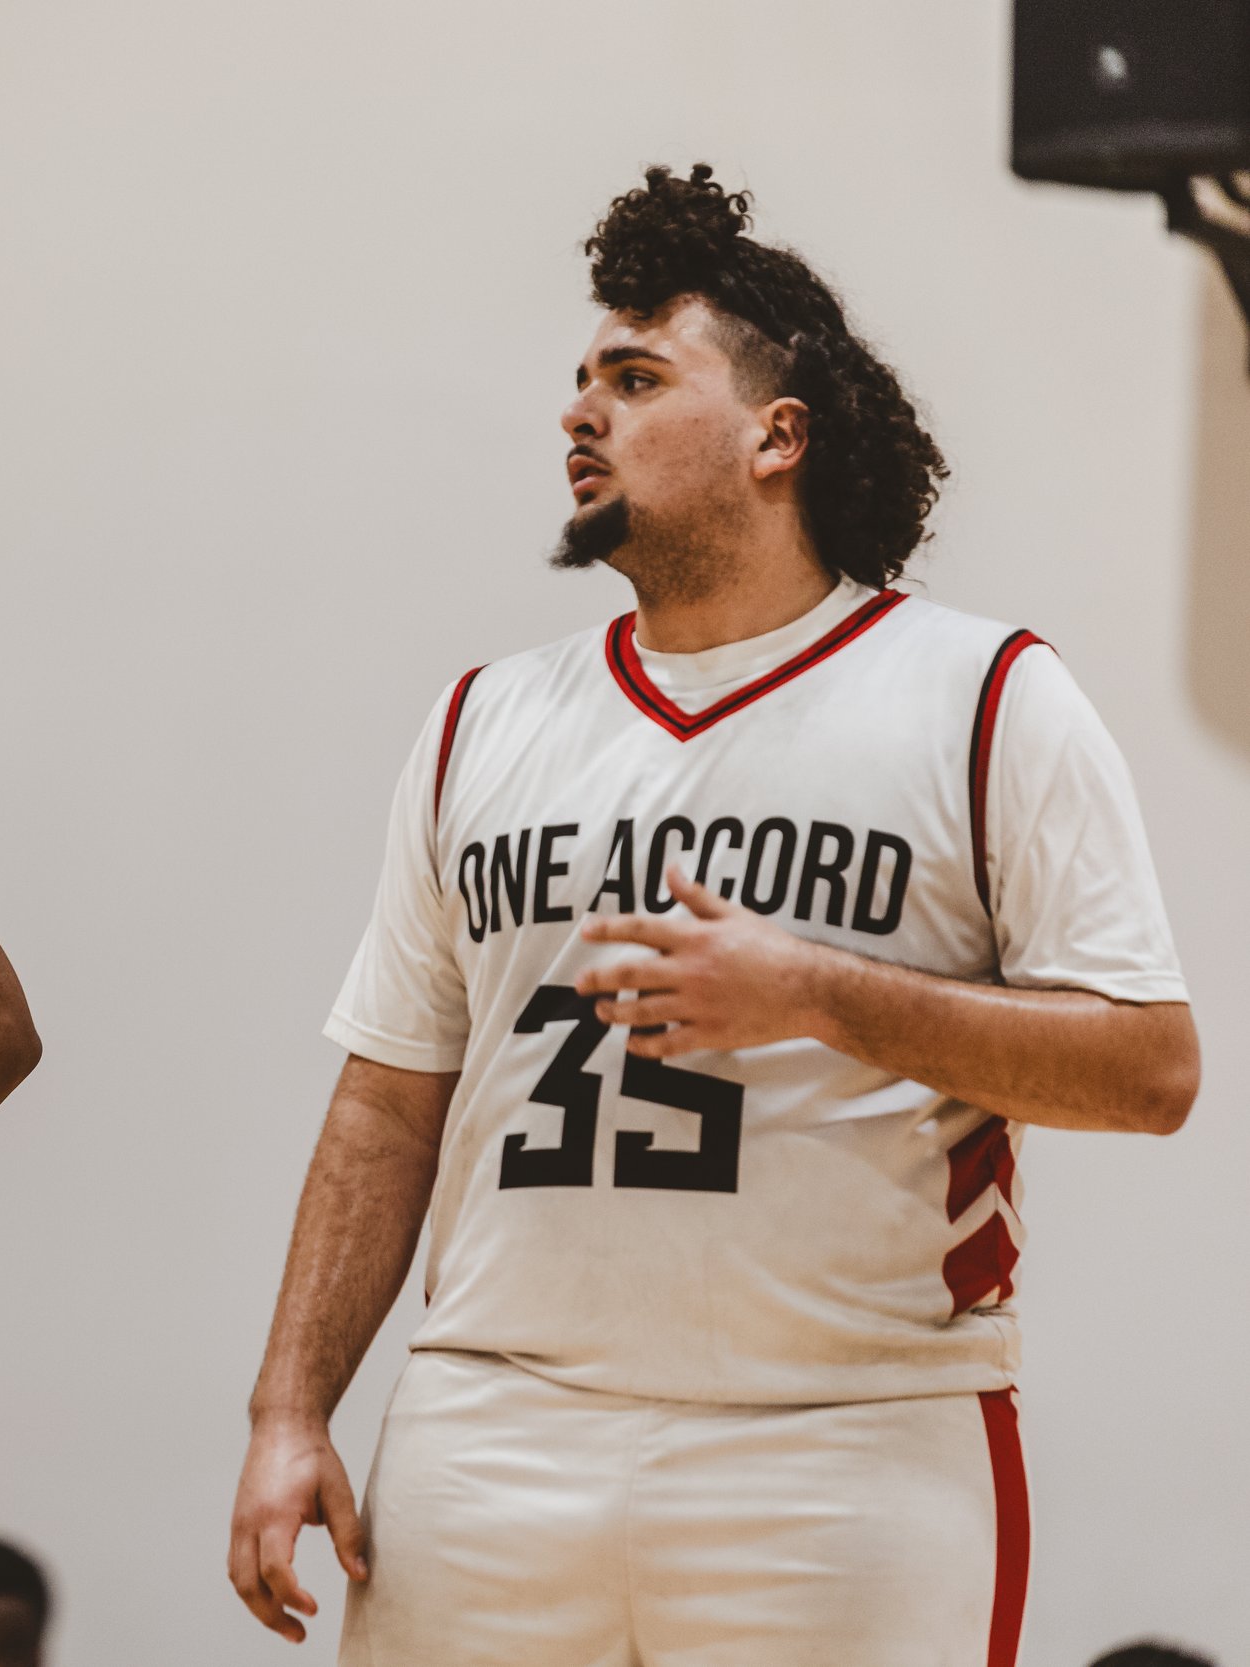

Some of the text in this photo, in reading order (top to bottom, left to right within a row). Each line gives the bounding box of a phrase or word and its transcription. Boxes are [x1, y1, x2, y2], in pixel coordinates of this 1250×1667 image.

[458, 815, 913, 944] ONE ACCORD
[498, 984, 745, 1193] 35
